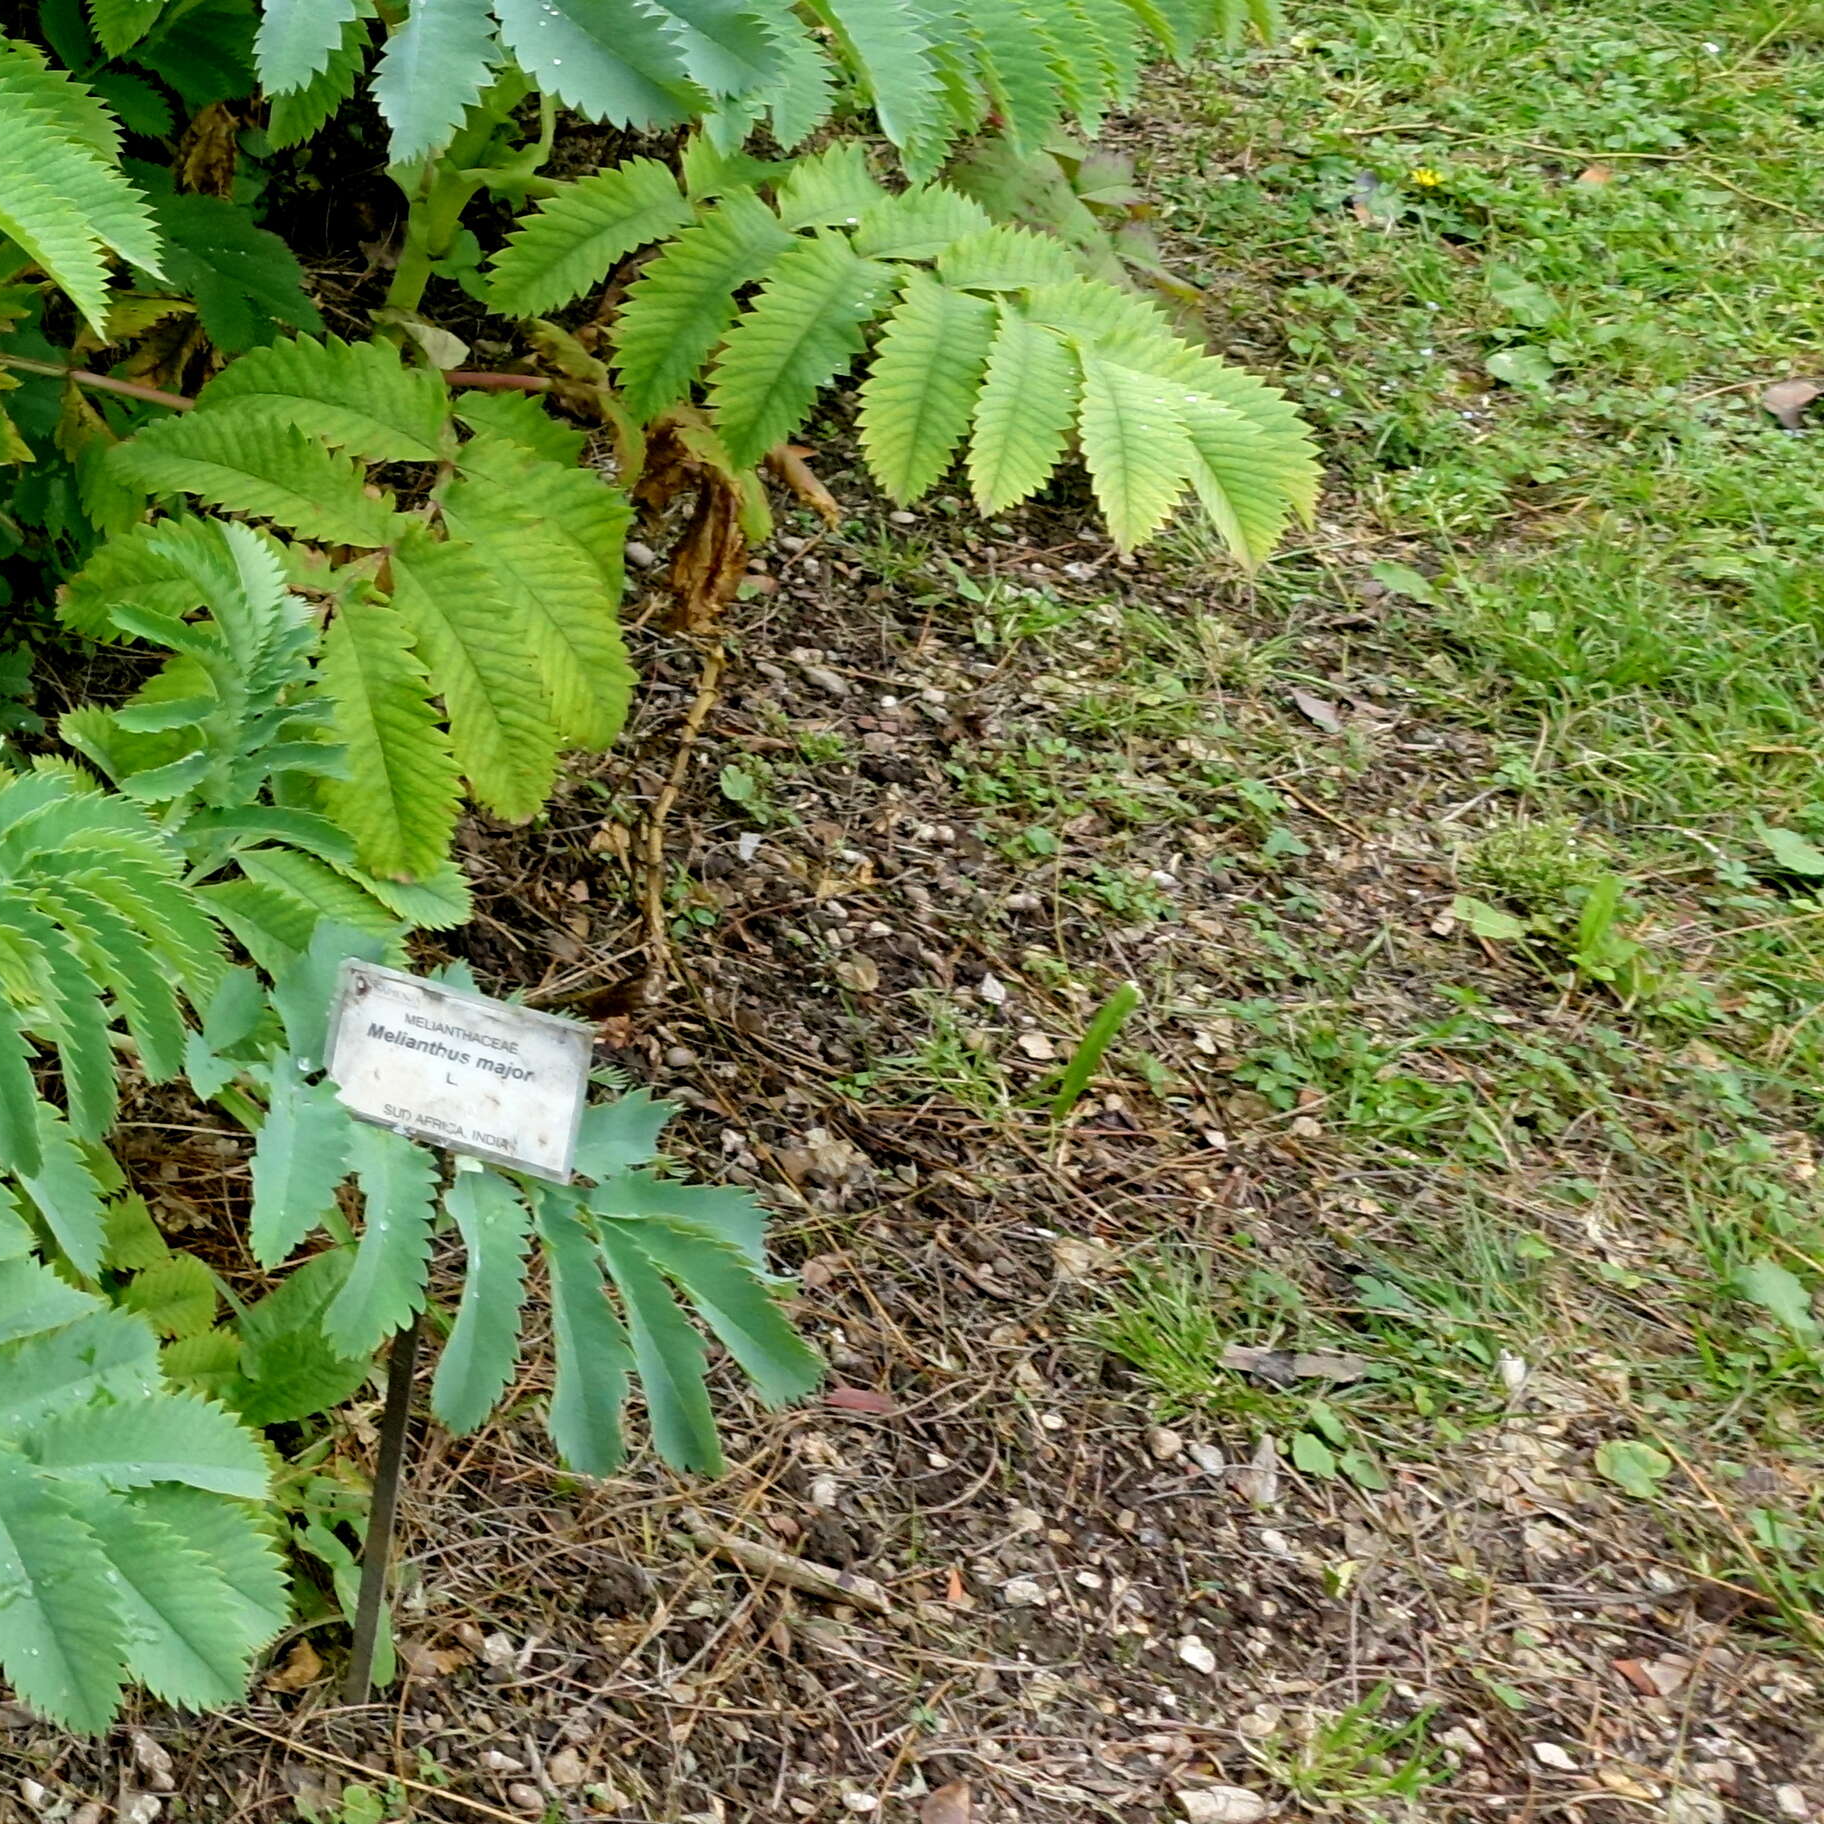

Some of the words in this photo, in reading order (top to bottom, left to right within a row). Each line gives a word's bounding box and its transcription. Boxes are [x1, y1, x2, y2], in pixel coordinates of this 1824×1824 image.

[367, 1023, 471, 1064] Melianthus
[476, 1056, 534, 1082] major
[405, 1013, 519, 1055] MELIANTHACEAE
[383, 1104, 412, 1121] SUD
